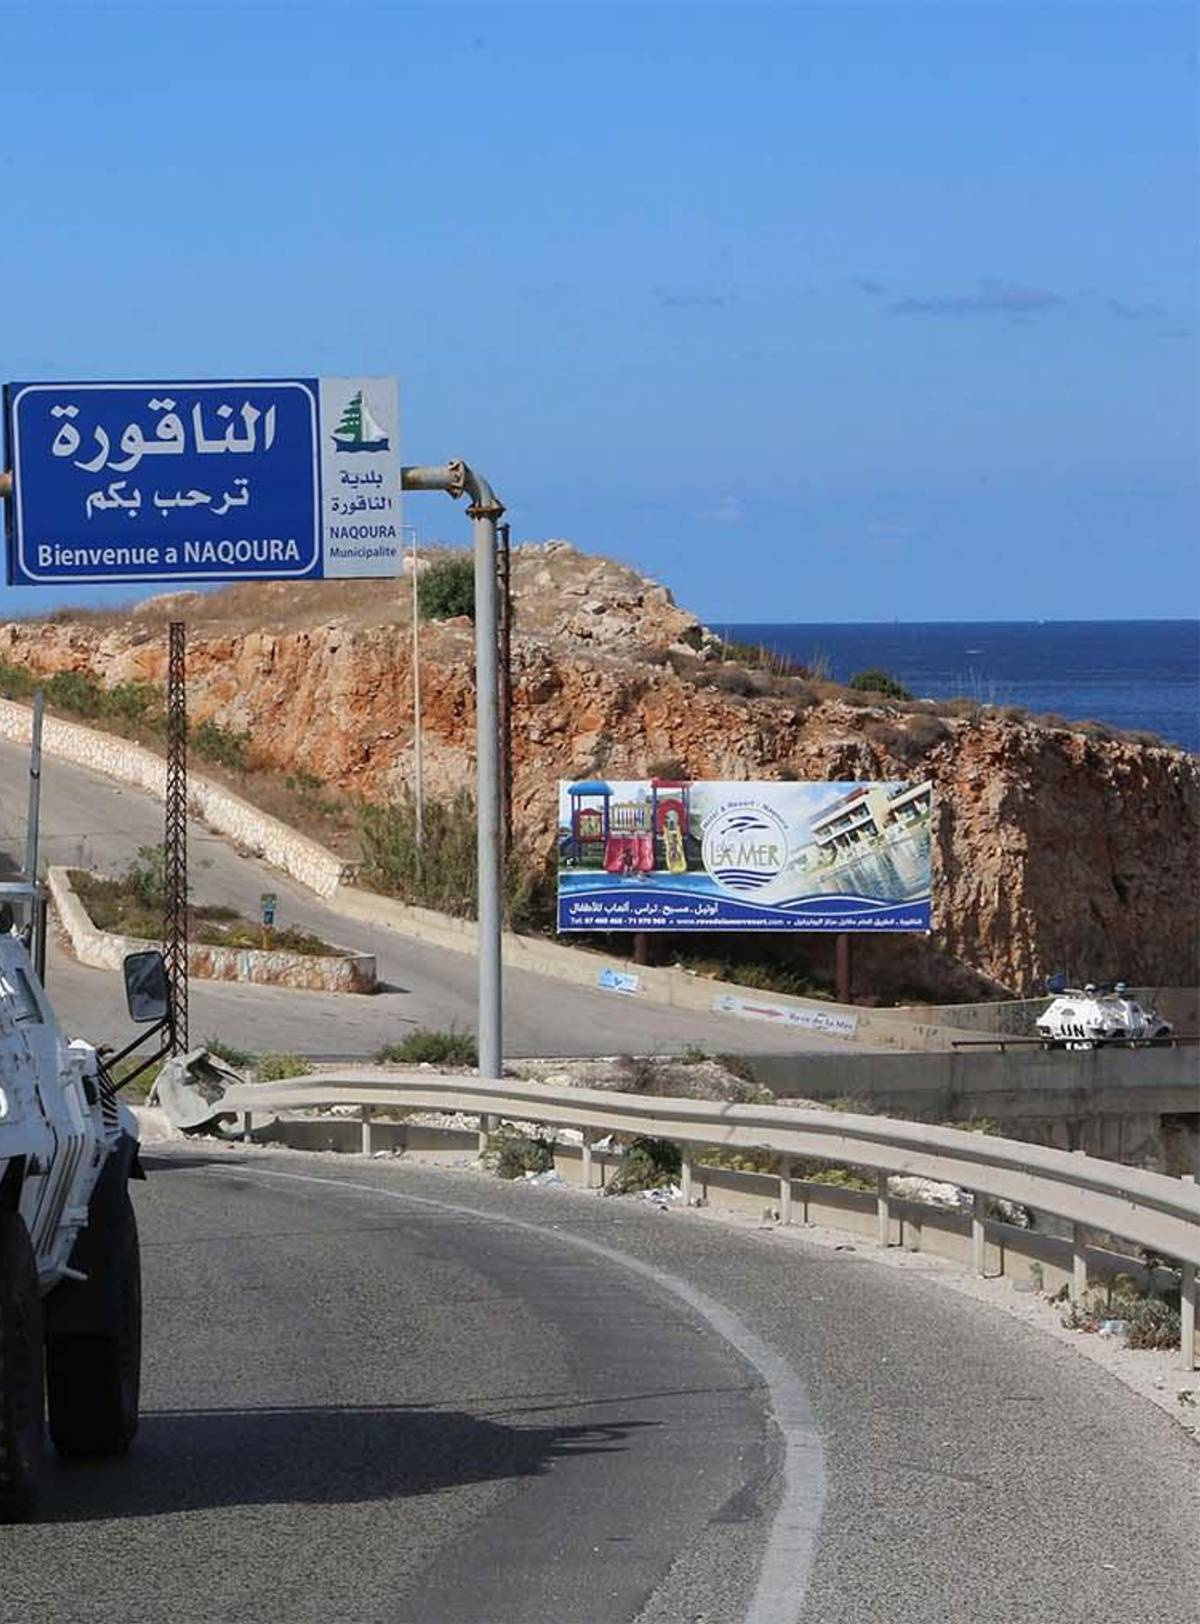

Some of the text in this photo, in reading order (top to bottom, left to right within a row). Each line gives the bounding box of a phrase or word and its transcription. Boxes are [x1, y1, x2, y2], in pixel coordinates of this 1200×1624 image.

[50, 397, 276, 473] الناقورة
[340, 469, 383, 489] بلدية
[86, 479, 250, 519] ترحب بكم
[331, 495, 392, 515] الناقورة
[329, 525, 397, 540] NAQOURA
[38, 539, 300, 567] Bienvenue a NAQOURA
[737, 842, 781, 867] MER
[1060, 1023, 1086, 1038] UN
